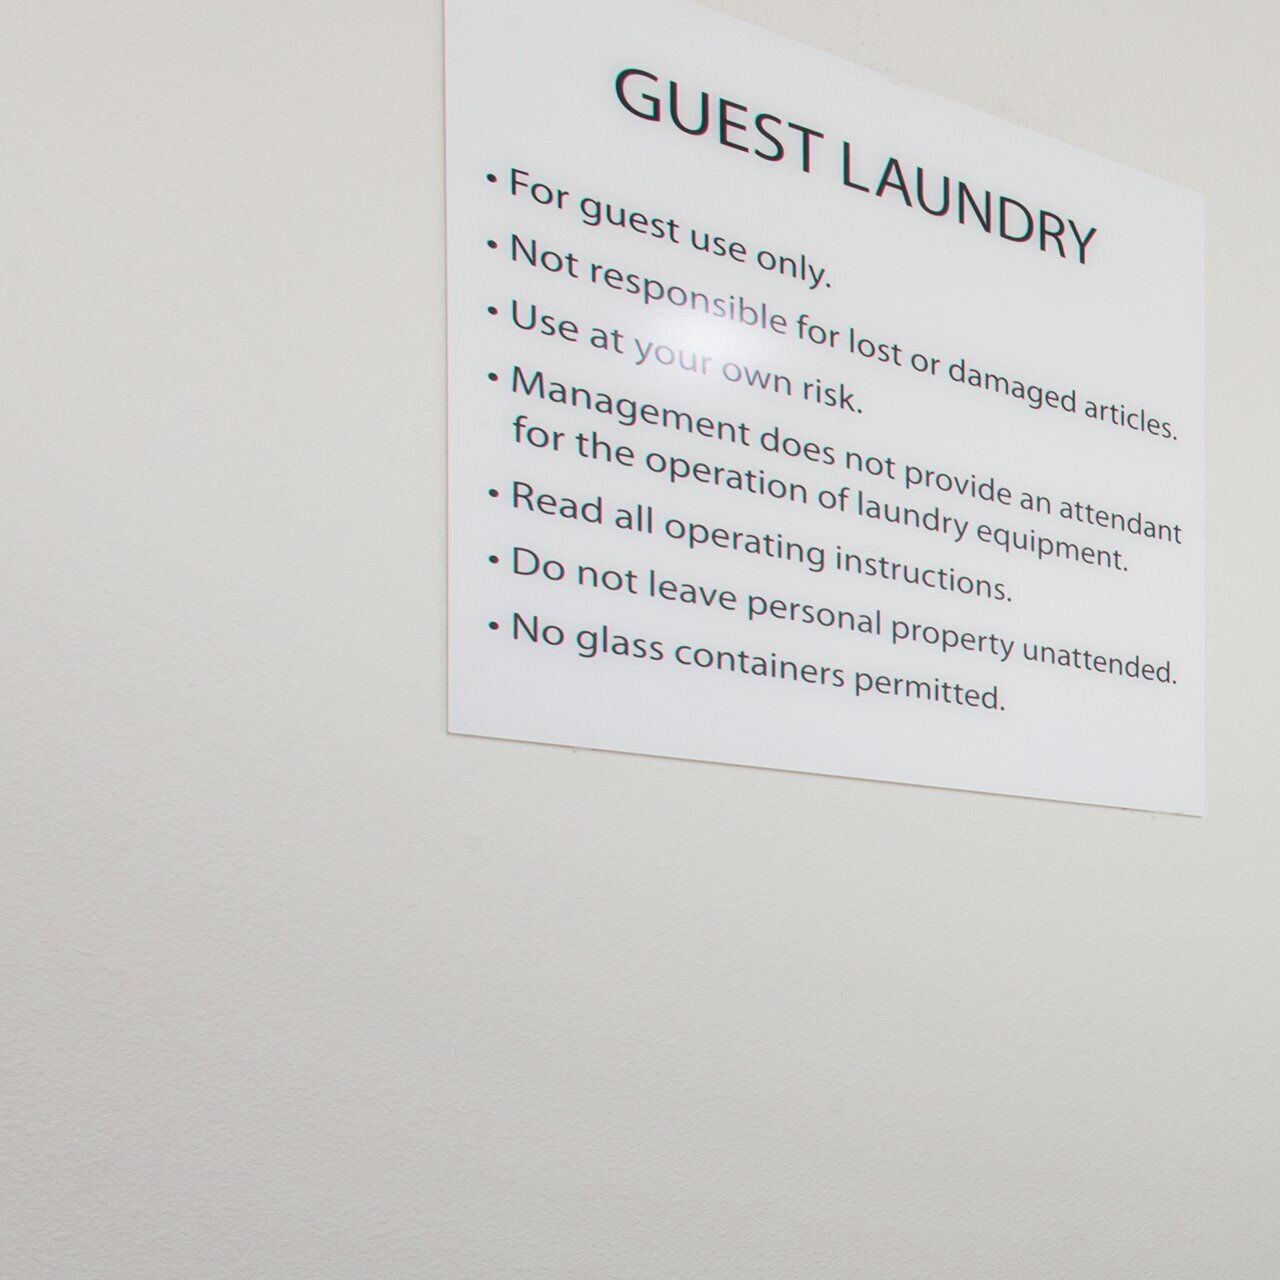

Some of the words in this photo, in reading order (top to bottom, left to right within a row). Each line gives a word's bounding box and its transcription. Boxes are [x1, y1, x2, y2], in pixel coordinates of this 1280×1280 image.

[510, 167, 570, 210] For
[579, 197, 681, 245] guest
[690, 228, 748, 264] use
[756, 250, 832, 291] only.
[614, 67, 825, 174] GUEST
[842, 140, 1098, 266] LAUNDRY
[511, 233, 580, 279] Not
[590, 262, 788, 335] responsible
[795, 313, 841, 349] for
[849, 326, 903, 367] lost
[910, 353, 942, 376] or
[948, 358, 1077, 414] damaged
[1084, 400, 1178, 442] articles.
[511, 298, 580, 343] Use
[589, 327, 625, 355] at
[633, 337, 712, 375] your
[722, 362, 792, 397] own
[803, 378, 863, 415] risk.
[511, 364, 751, 447] Management
[759, 425, 836, 466] does
[845, 450, 897, 481] not
[904, 464, 1013, 506] provide
[1019, 491, 1052, 516] an
[1058, 501, 1183, 545] attendant
[511, 414, 566, 452] for
[574, 430, 636, 468] the
[645, 452, 808, 505] operation
[817, 486, 851, 513] of
[857, 489, 970, 544] laundry
[976, 523, 1129, 572] equipment.
[512, 480, 603, 525] Read
[614, 503, 653, 535] all
[664, 518, 826, 573] operating
[836, 544, 1012, 603] instructions.
[512, 546, 566, 582] Do
[577, 565, 639, 595] not
[649, 568, 738, 611] leave
[747, 594, 882, 636] personal
[891, 619, 1016, 663] property
[1022, 642, 1177, 685] unattended.
[512, 611, 565, 647] No
[575, 624, 665, 662] glass
[674, 645, 846, 688] containers
[854, 671, 1006, 712] permitted.
